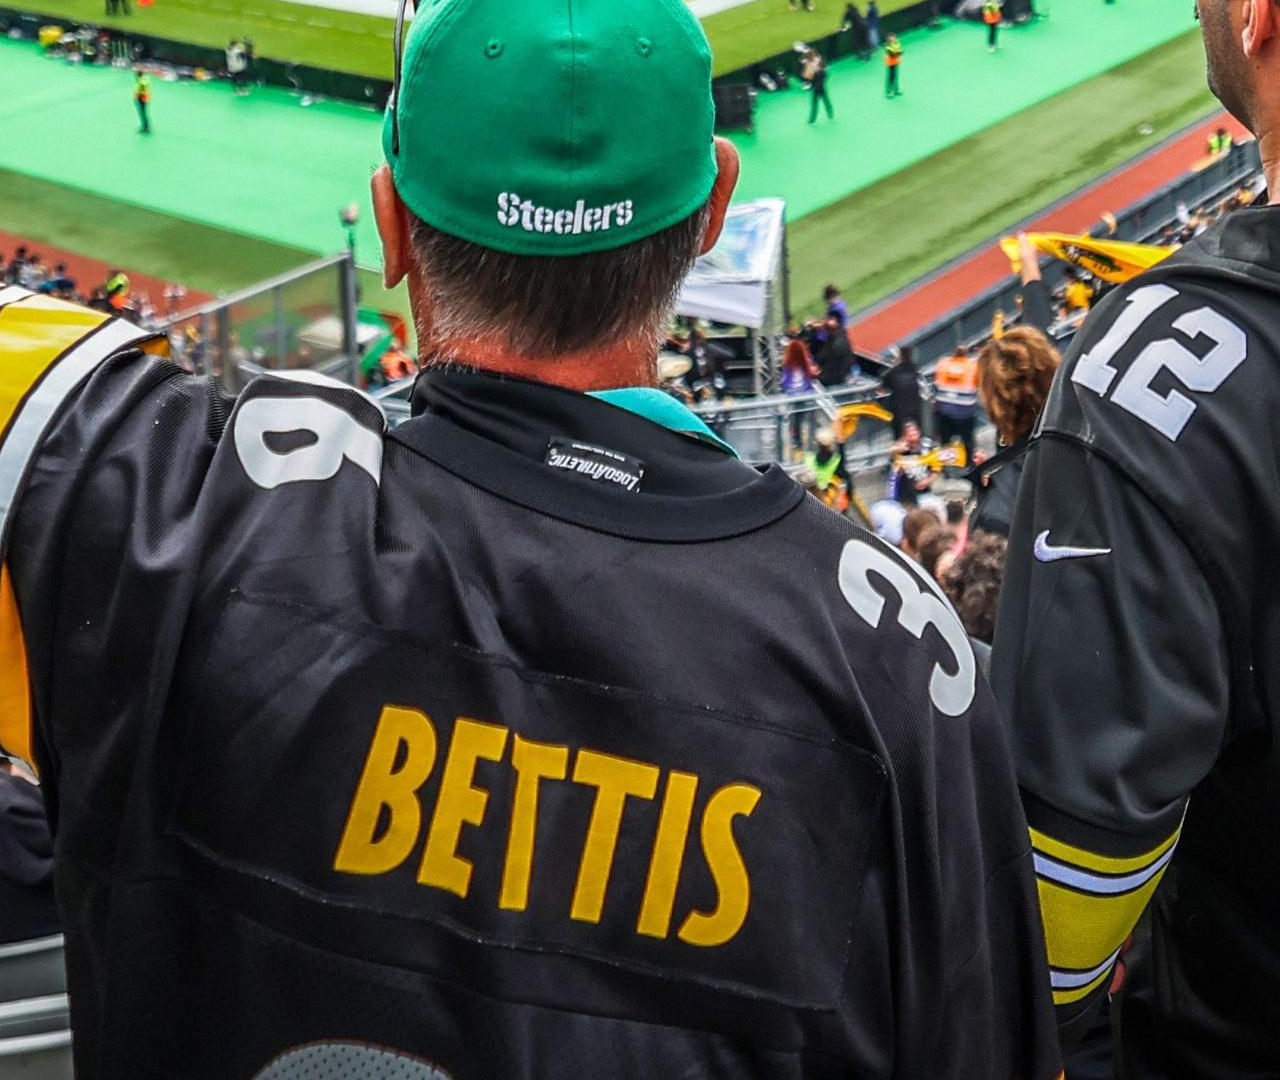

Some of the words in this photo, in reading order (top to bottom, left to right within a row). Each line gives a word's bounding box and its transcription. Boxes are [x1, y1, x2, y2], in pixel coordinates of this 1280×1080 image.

[497, 191, 633, 235] Steelers
[1071, 284, 1247, 442] 12
[333, 704, 762, 947] BETTIS
